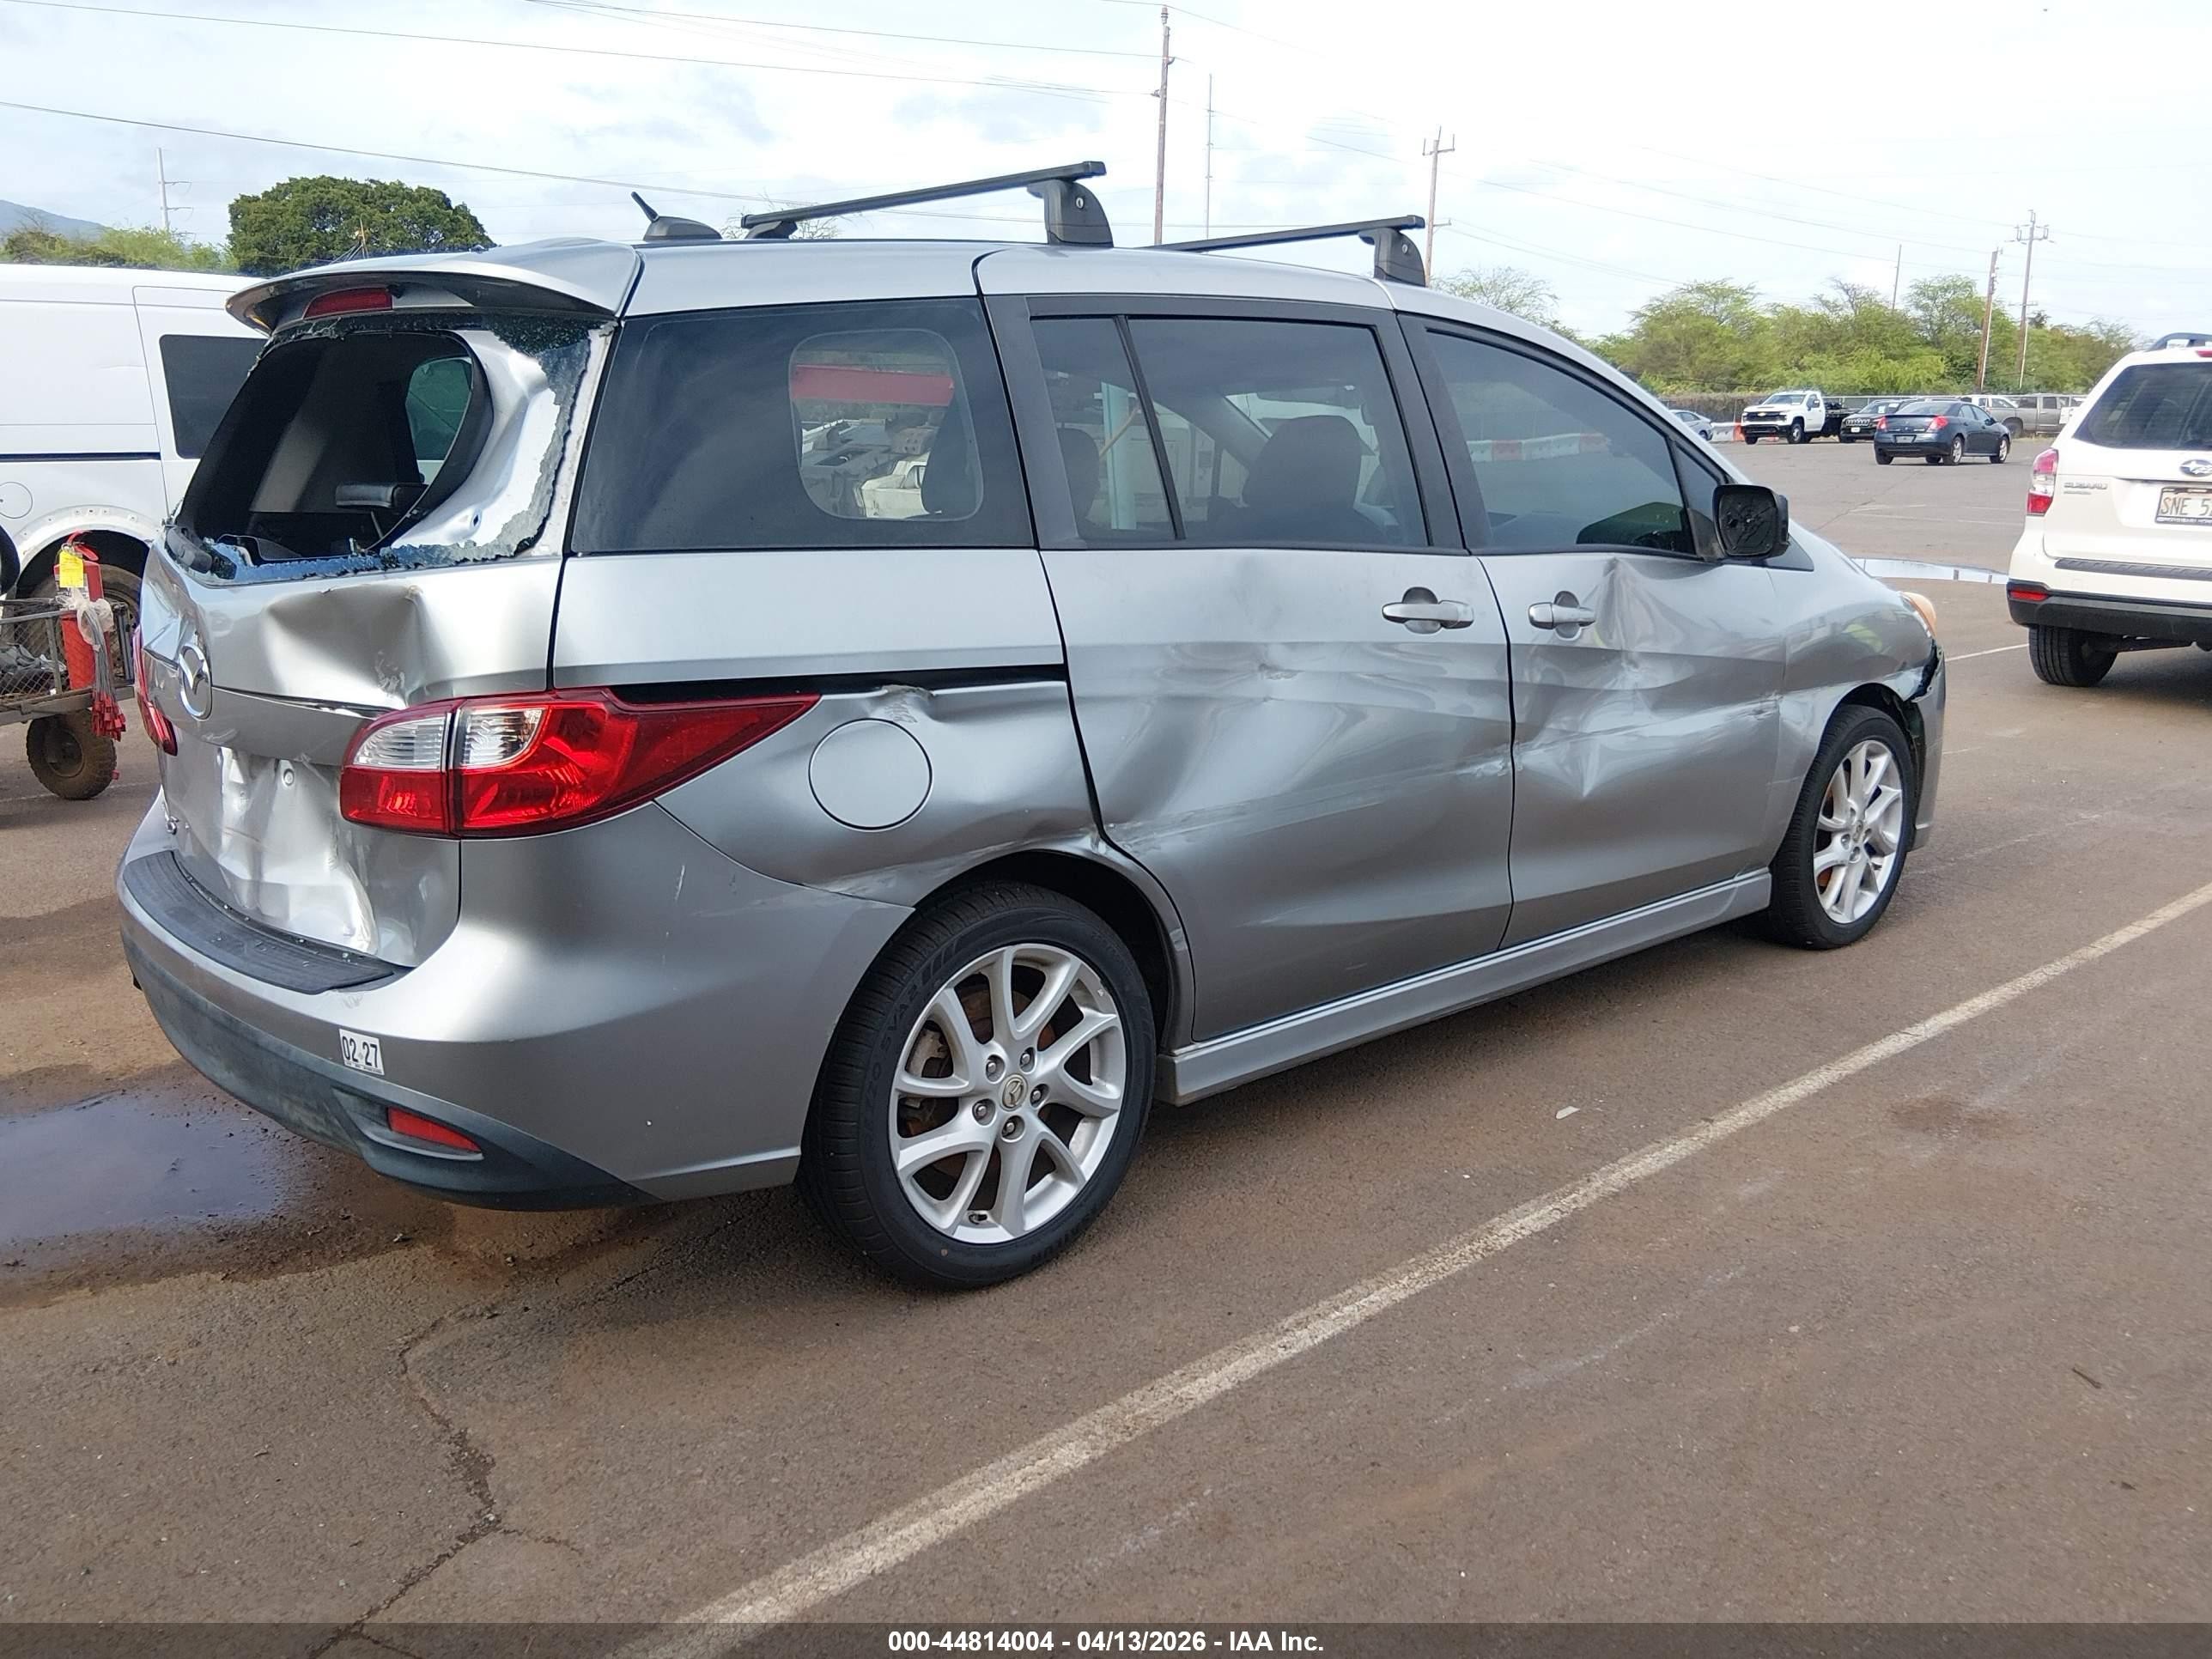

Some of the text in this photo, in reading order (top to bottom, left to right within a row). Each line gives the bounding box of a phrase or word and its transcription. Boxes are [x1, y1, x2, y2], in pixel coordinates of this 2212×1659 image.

[2160, 497, 2191, 515] SNE
[342, 1036, 358, 1063] 02
[362, 1042, 379, 1068] 27
